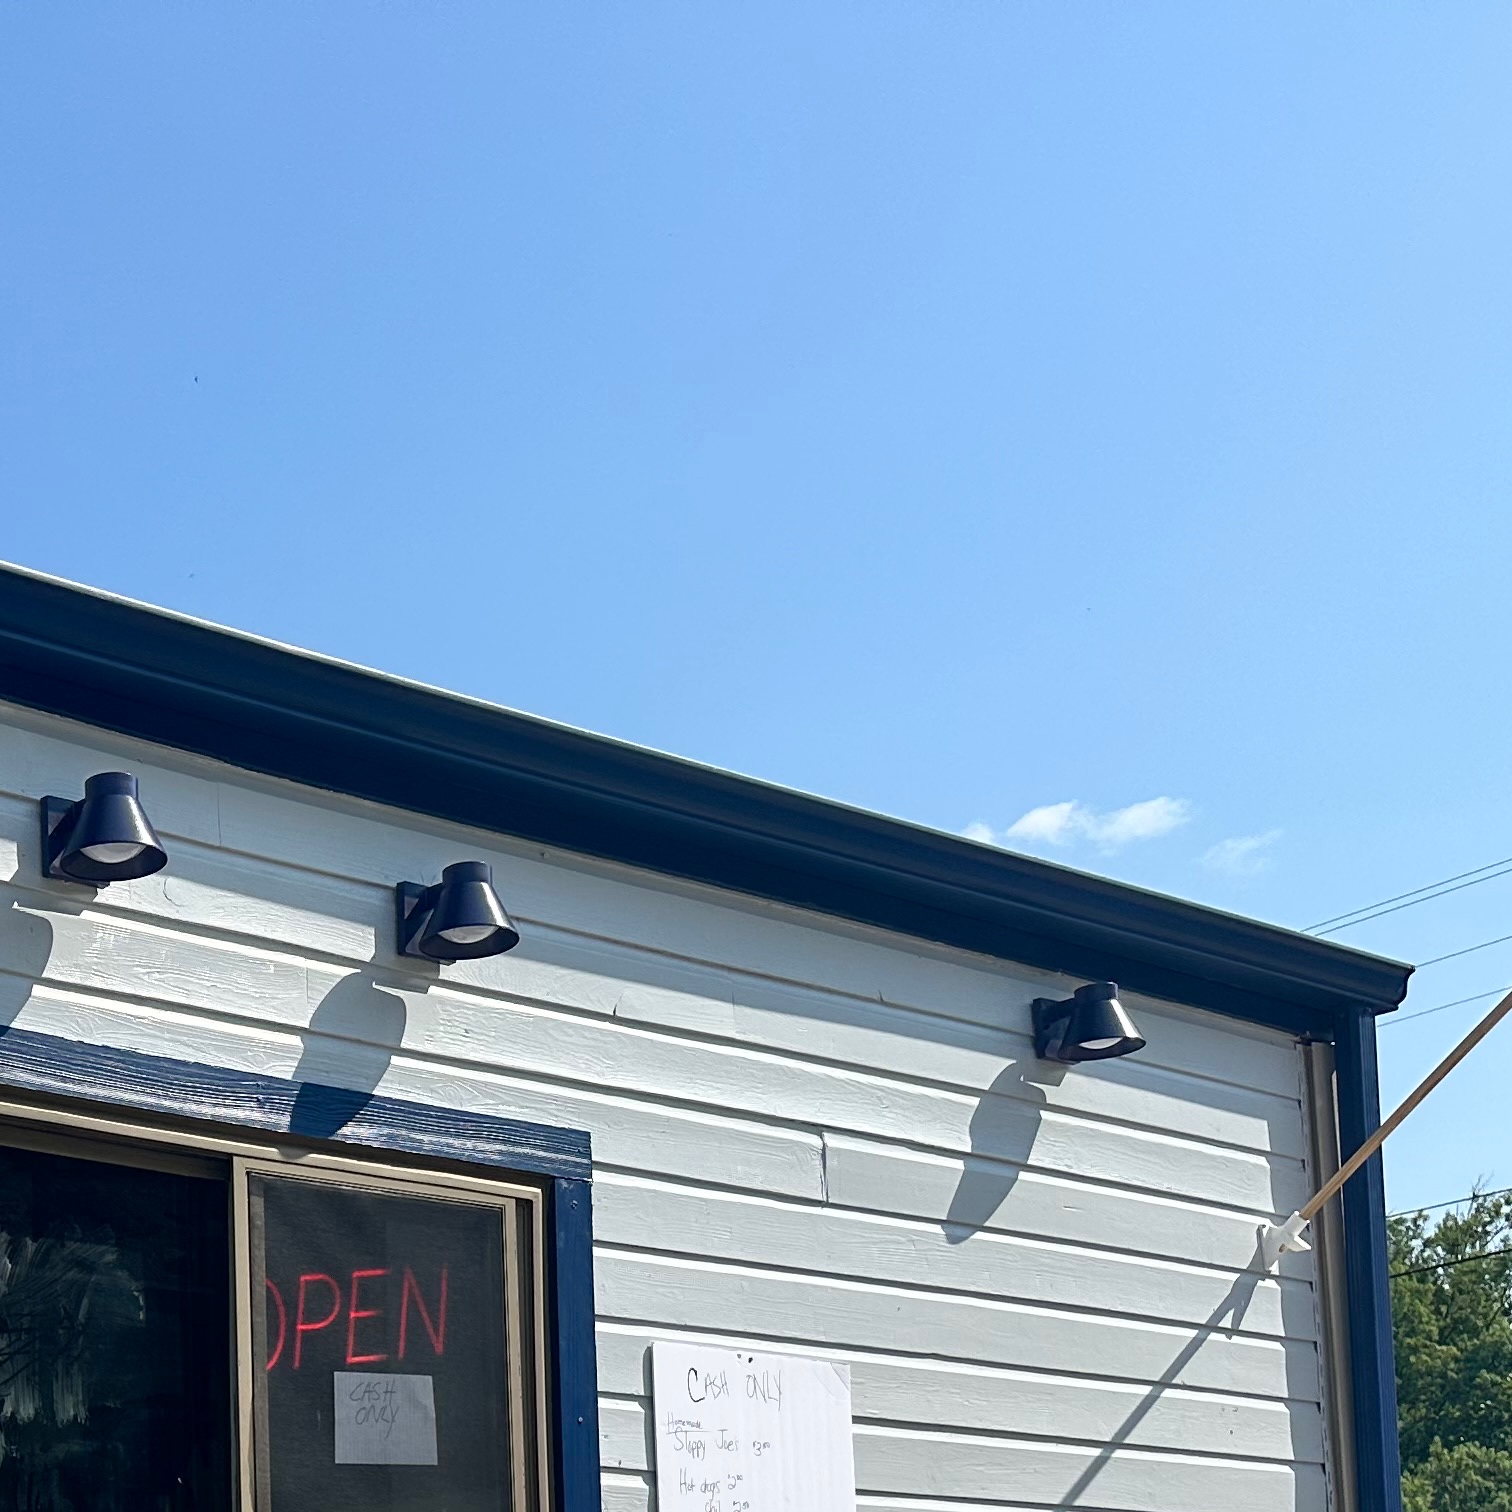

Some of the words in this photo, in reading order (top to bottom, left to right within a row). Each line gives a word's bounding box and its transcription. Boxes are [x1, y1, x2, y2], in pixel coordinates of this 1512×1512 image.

[349, 1378, 396, 1402] CASH
[746, 1370, 783, 1412] ONLY
[354, 1404, 400, 1440] ONLY
